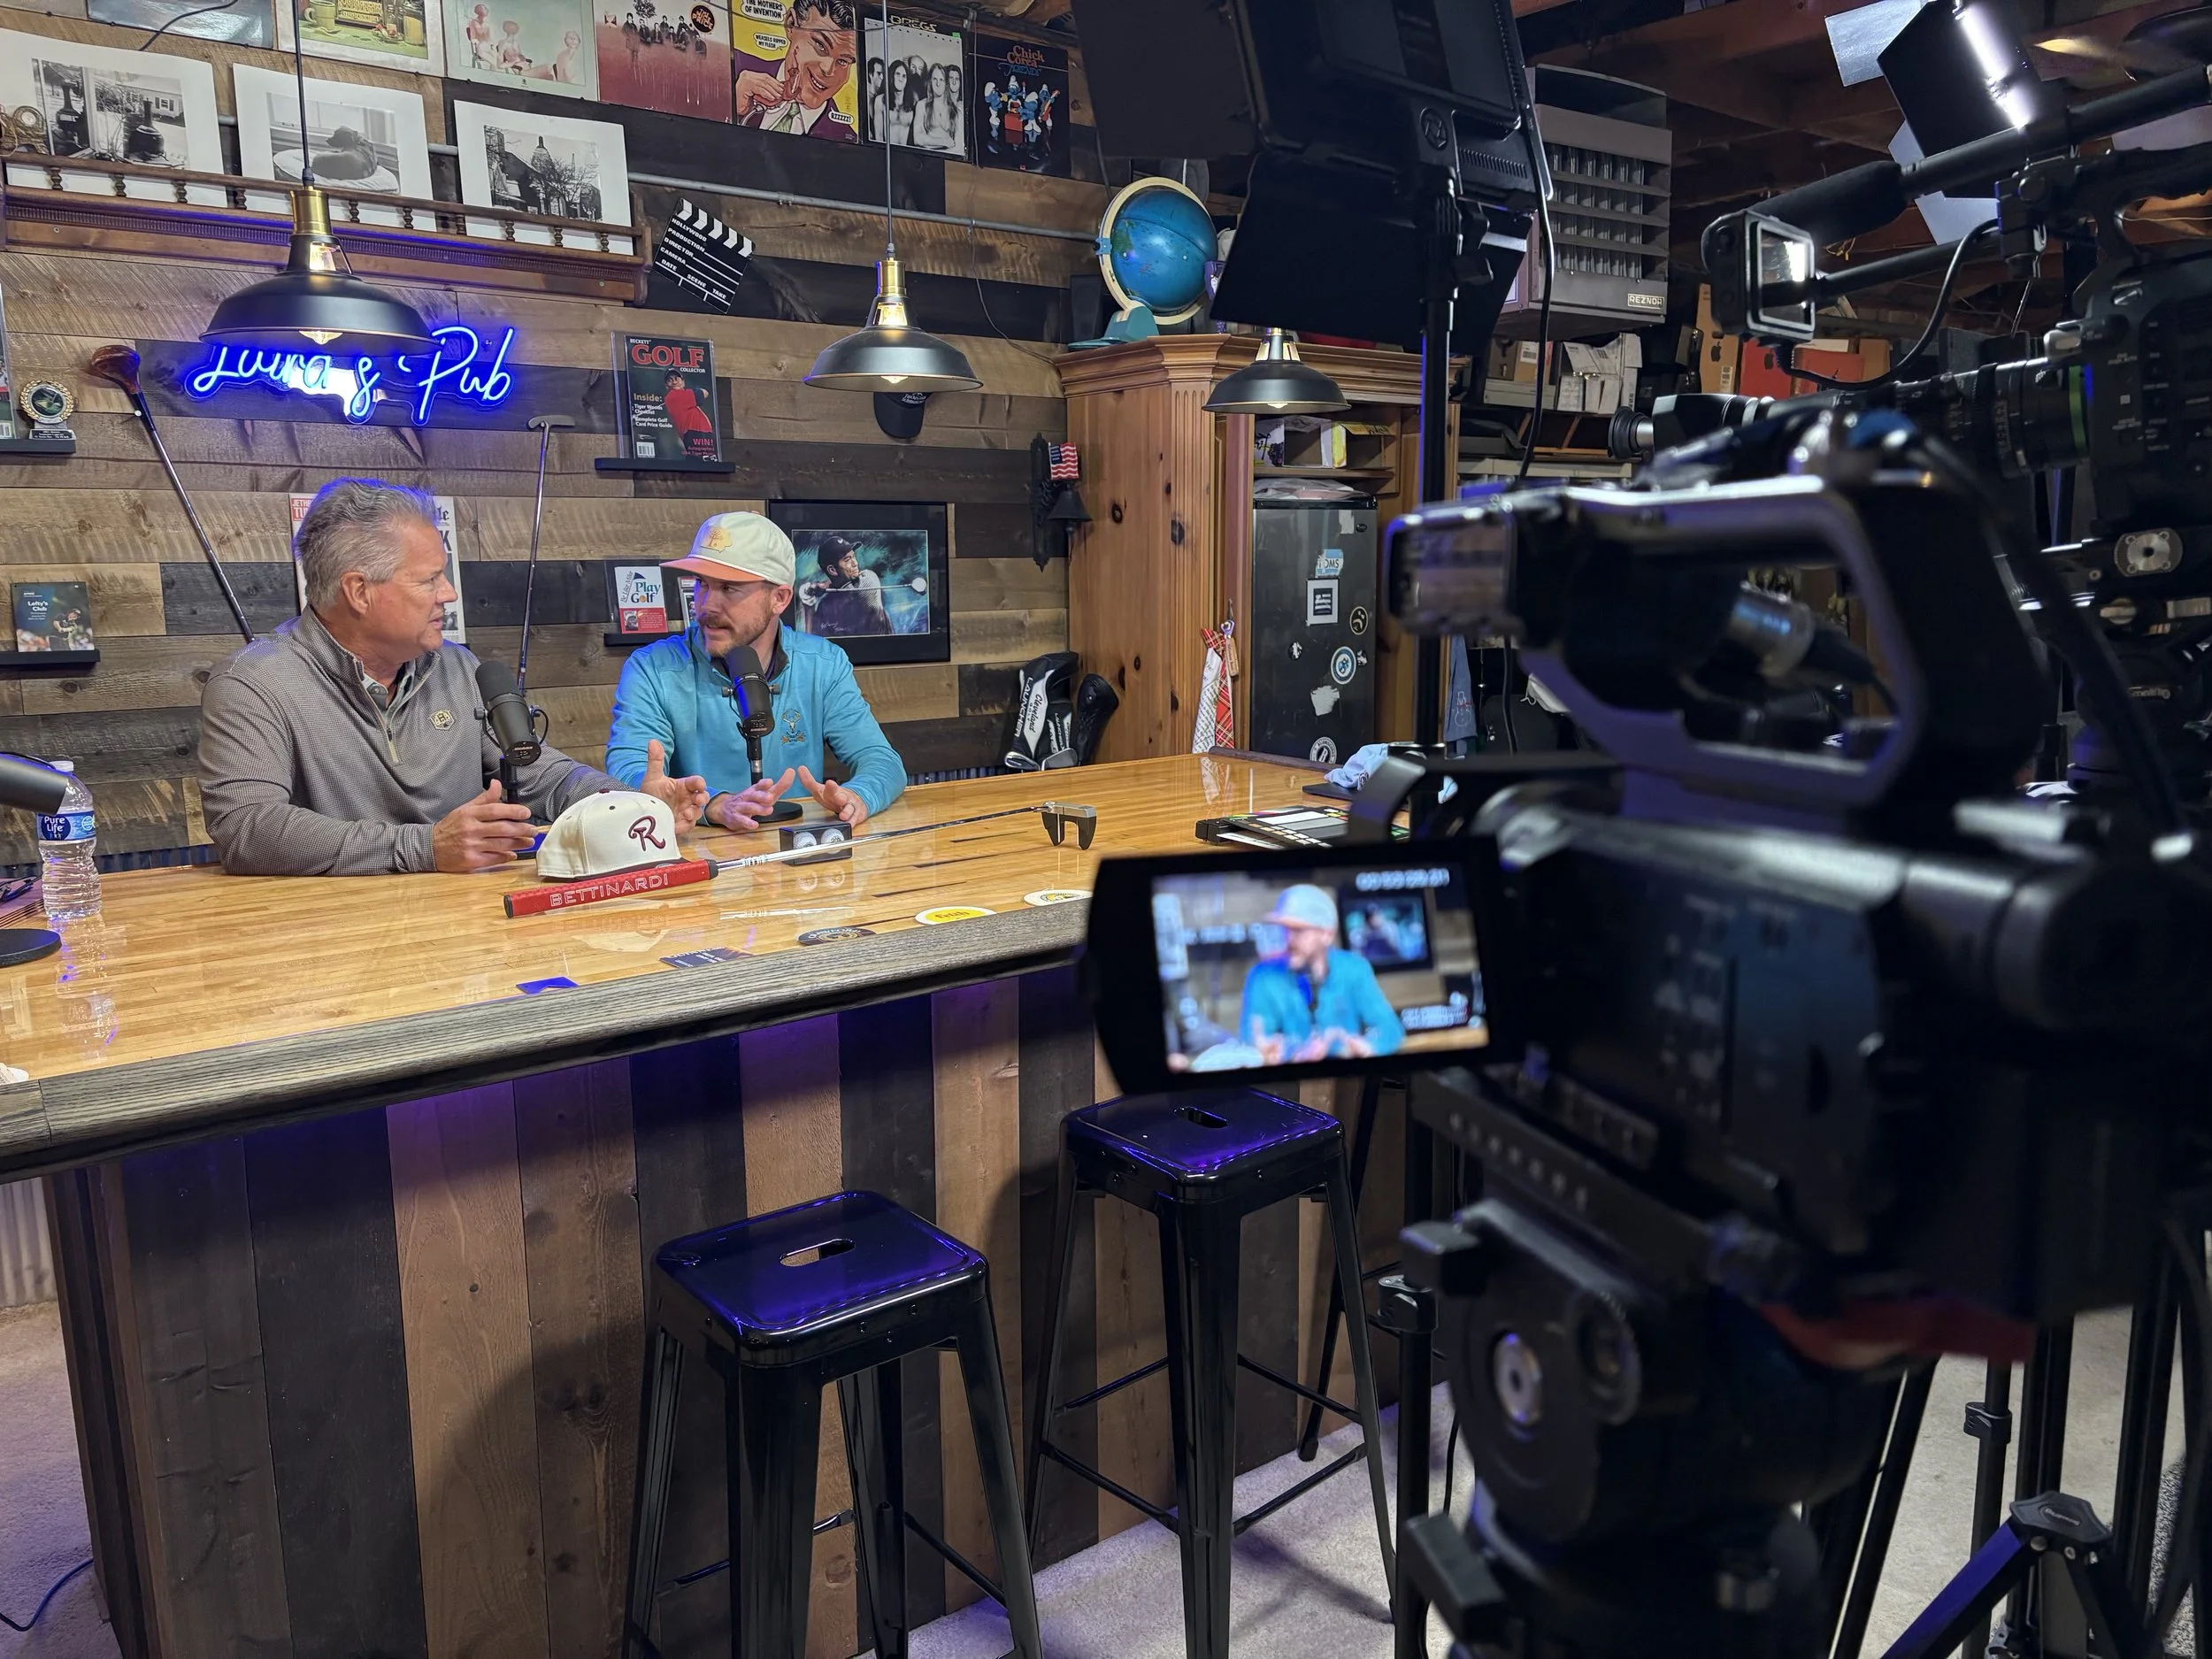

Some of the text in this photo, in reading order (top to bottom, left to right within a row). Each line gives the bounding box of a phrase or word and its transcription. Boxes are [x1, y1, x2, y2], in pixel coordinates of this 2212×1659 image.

[753, 7, 782, 19] INVENTION
[757, 0, 783, 12] MOTHERS
[1007, 51, 1038, 68] Corea
[1013, 45, 1045, 63] Chick
[672, 218, 707, 242] HOLLYWOOD
[664, 237, 694, 257] DIRECTOR
[668, 227, 705, 253] PRODUCTION
[660, 246, 686, 265] CAMERA
[661, 258, 727, 300] DATE SCENE TAKE
[1629, 296, 1663, 306] REZNOR
[631, 344, 705, 368] GOLF
[418, 326, 514, 422] Pub
[634, 393, 663, 403] Inside:
[635, 581, 661, 595] Play
[630, 593, 656, 603] Golf
[1014, 676, 1033, 738] LAUNCHER
[1029, 694, 1043, 733] Cleveland
[47, 824, 65, 833] Life
[628, 815, 665, 852] R
[549, 873, 669, 907] BETTINARDI
